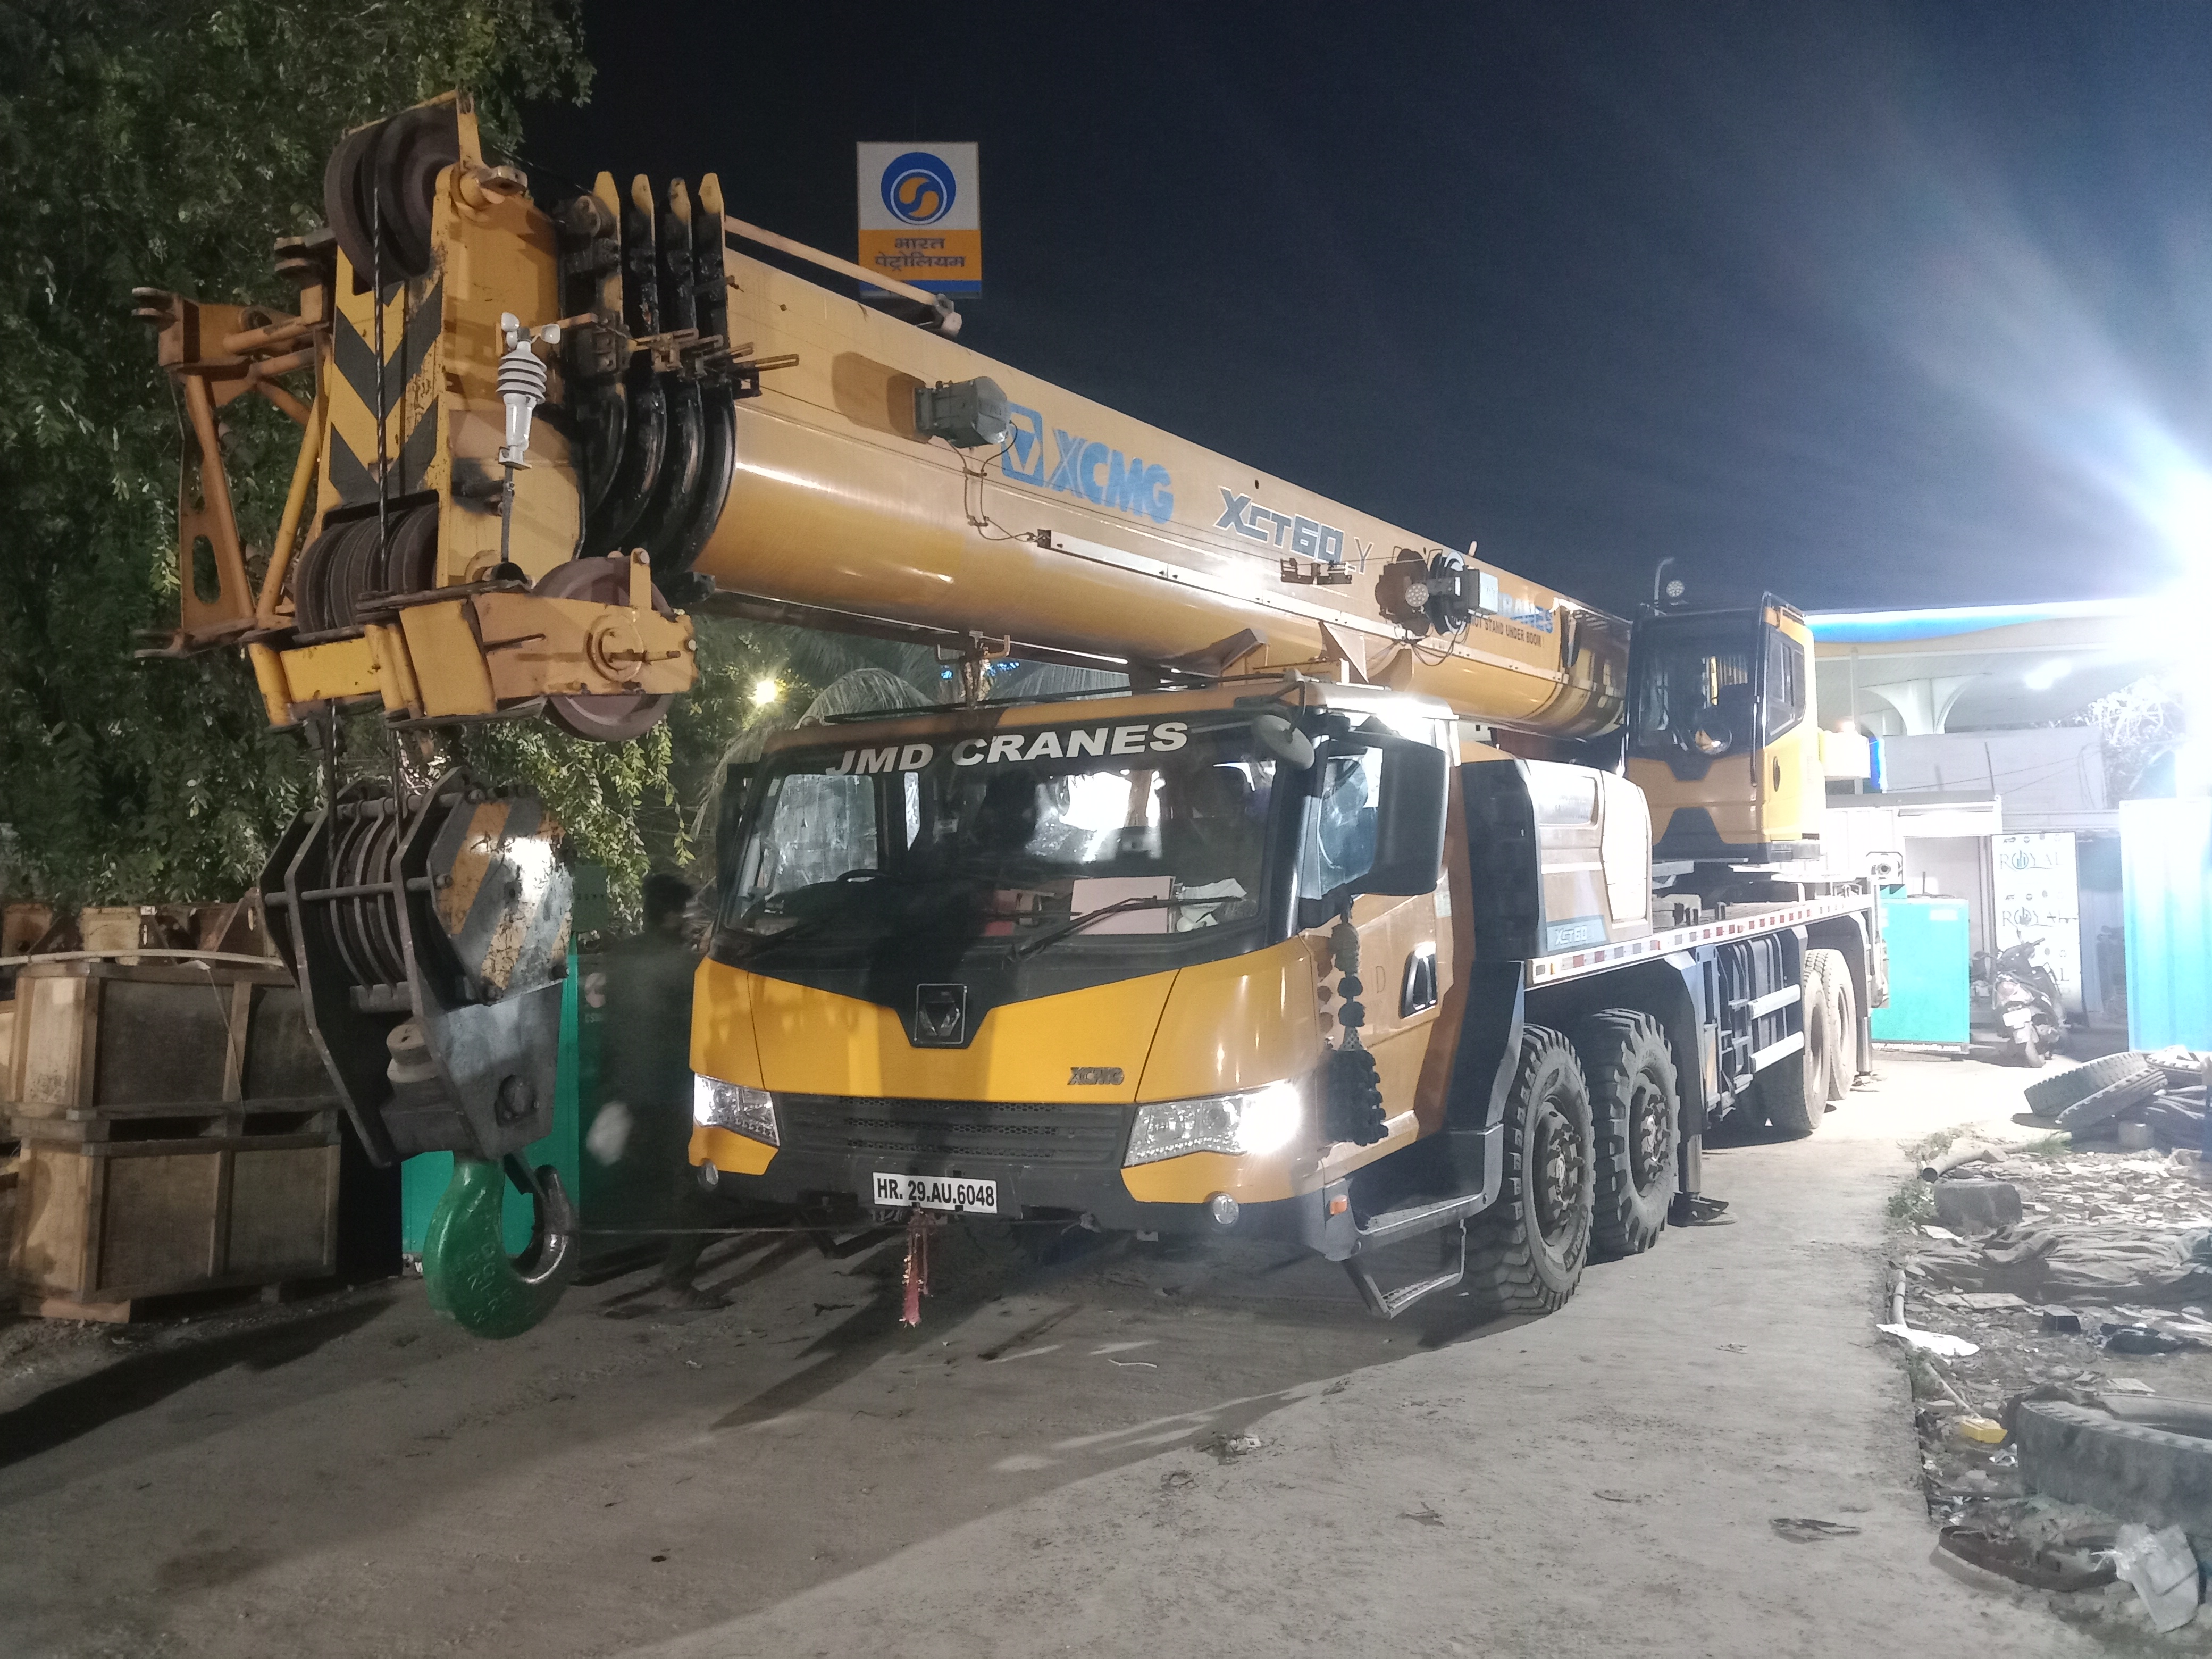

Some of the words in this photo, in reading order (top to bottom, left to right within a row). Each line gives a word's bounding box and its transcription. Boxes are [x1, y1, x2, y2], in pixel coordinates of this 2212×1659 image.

[894, 238, 945, 249] भारत
[874, 250, 966, 272] पेट्रोलियम
[1050, 428, 1174, 525] XCMG
[1485, 618, 1504, 635] STAND
[1505, 624, 1525, 642] UNDER
[825, 744, 934, 776] JMD
[952, 722, 1188, 766] CRANES
[1067, 1067, 1125, 1085] XCMG
[877, 1178, 903, 1200] HR.
[908, 1180, 995, 1207] 29.AU.6048
